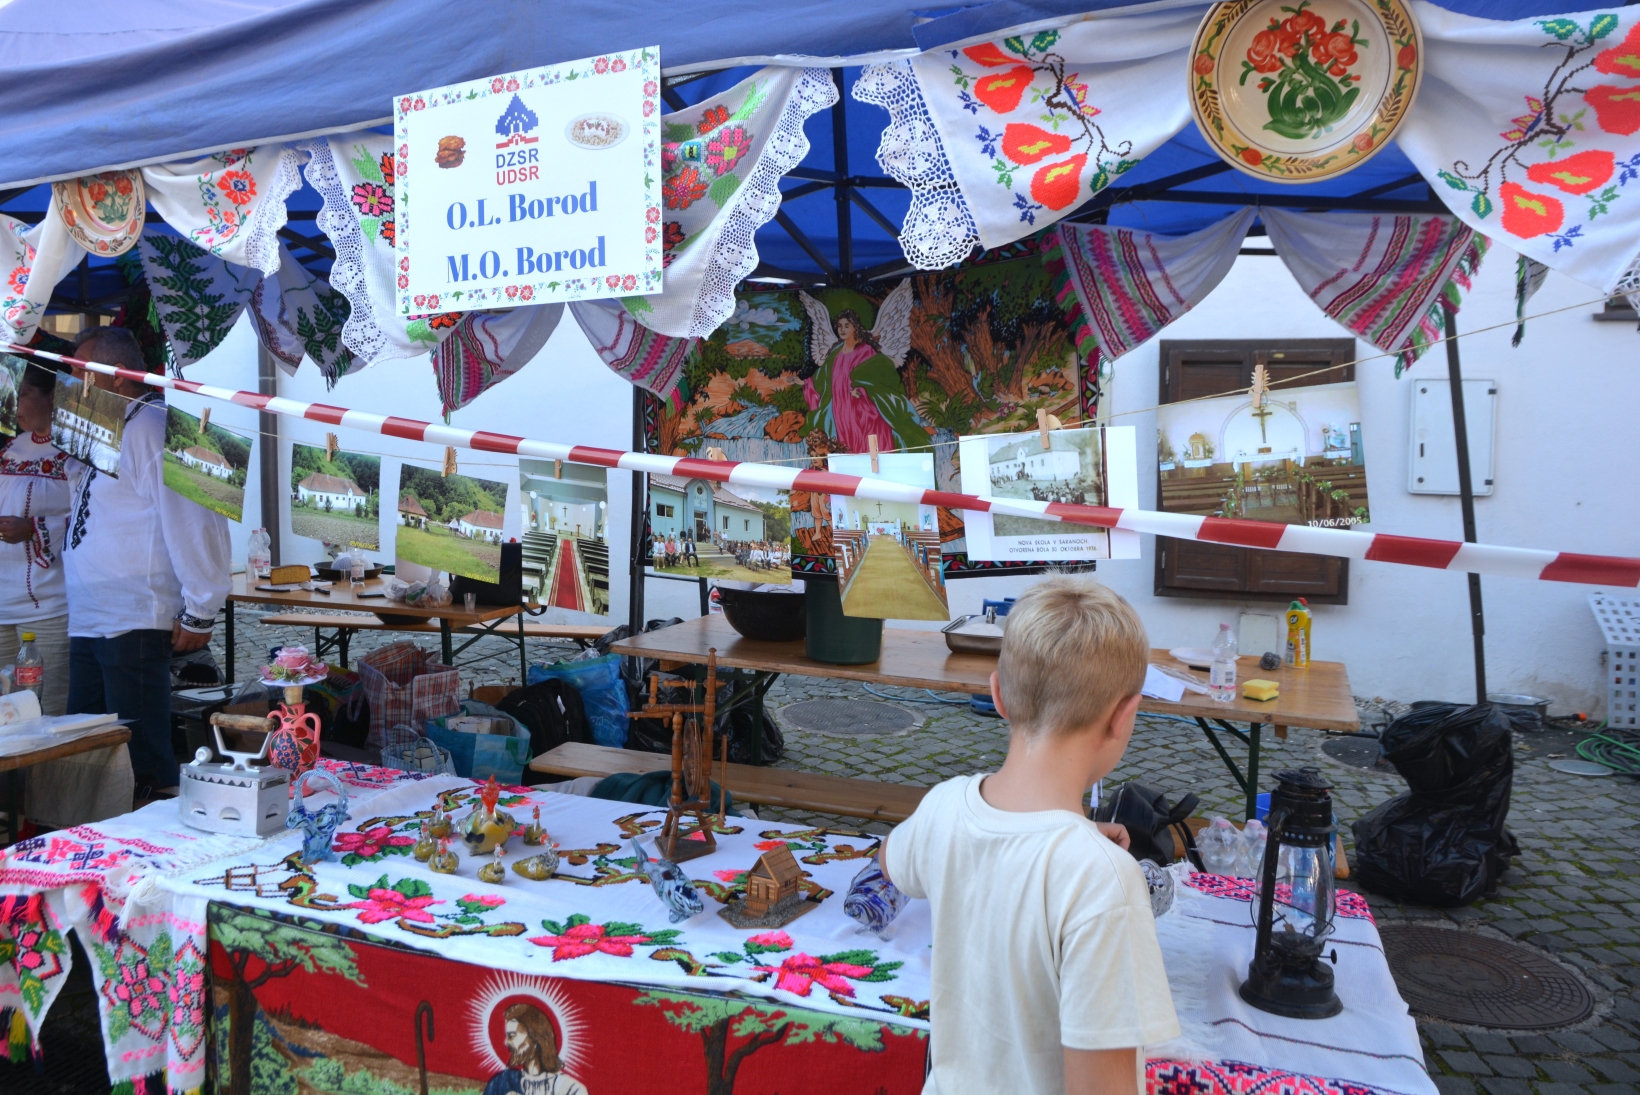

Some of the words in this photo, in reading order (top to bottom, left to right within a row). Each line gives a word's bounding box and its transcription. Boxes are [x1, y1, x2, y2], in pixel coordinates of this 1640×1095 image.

[496, 148, 539, 169] DZSR
[496, 165, 540, 186] UDSR
[446, 198, 501, 231] O.L.
[508, 180, 598, 223] Borod
[446, 249, 509, 283] M.O.
[515, 235, 607, 276] Borod
[1307, 516, 1362, 528] 10/06/2005
